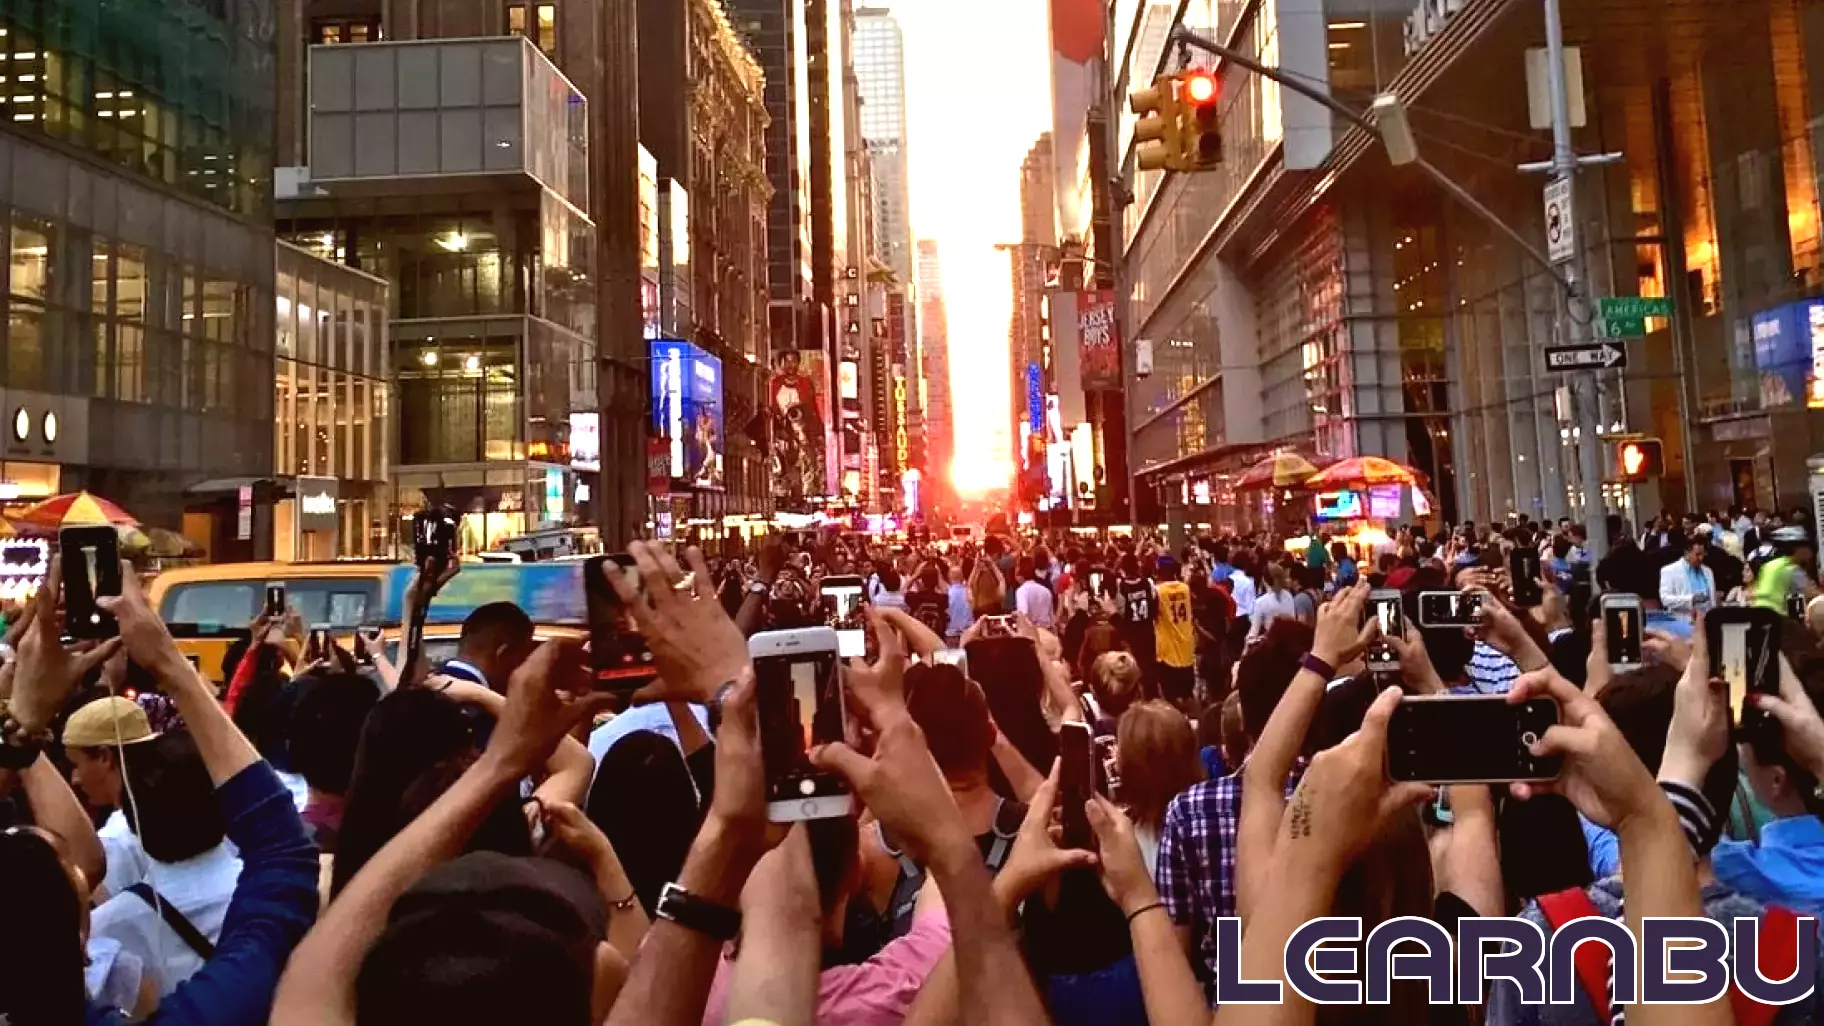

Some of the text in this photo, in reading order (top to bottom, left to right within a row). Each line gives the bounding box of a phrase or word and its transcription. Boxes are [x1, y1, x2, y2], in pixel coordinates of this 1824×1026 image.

[1080, 302, 1113, 328] JERSEY
[1607, 303, 1669, 314] AMERICAS
[1084, 325, 1110, 347] BOYS
[1610, 321, 1622, 337] 6
[1556, 349, 1613, 364] ONE WAY
[1131, 600, 1149, 621] 14
[1170, 602, 1187, 624] 14
